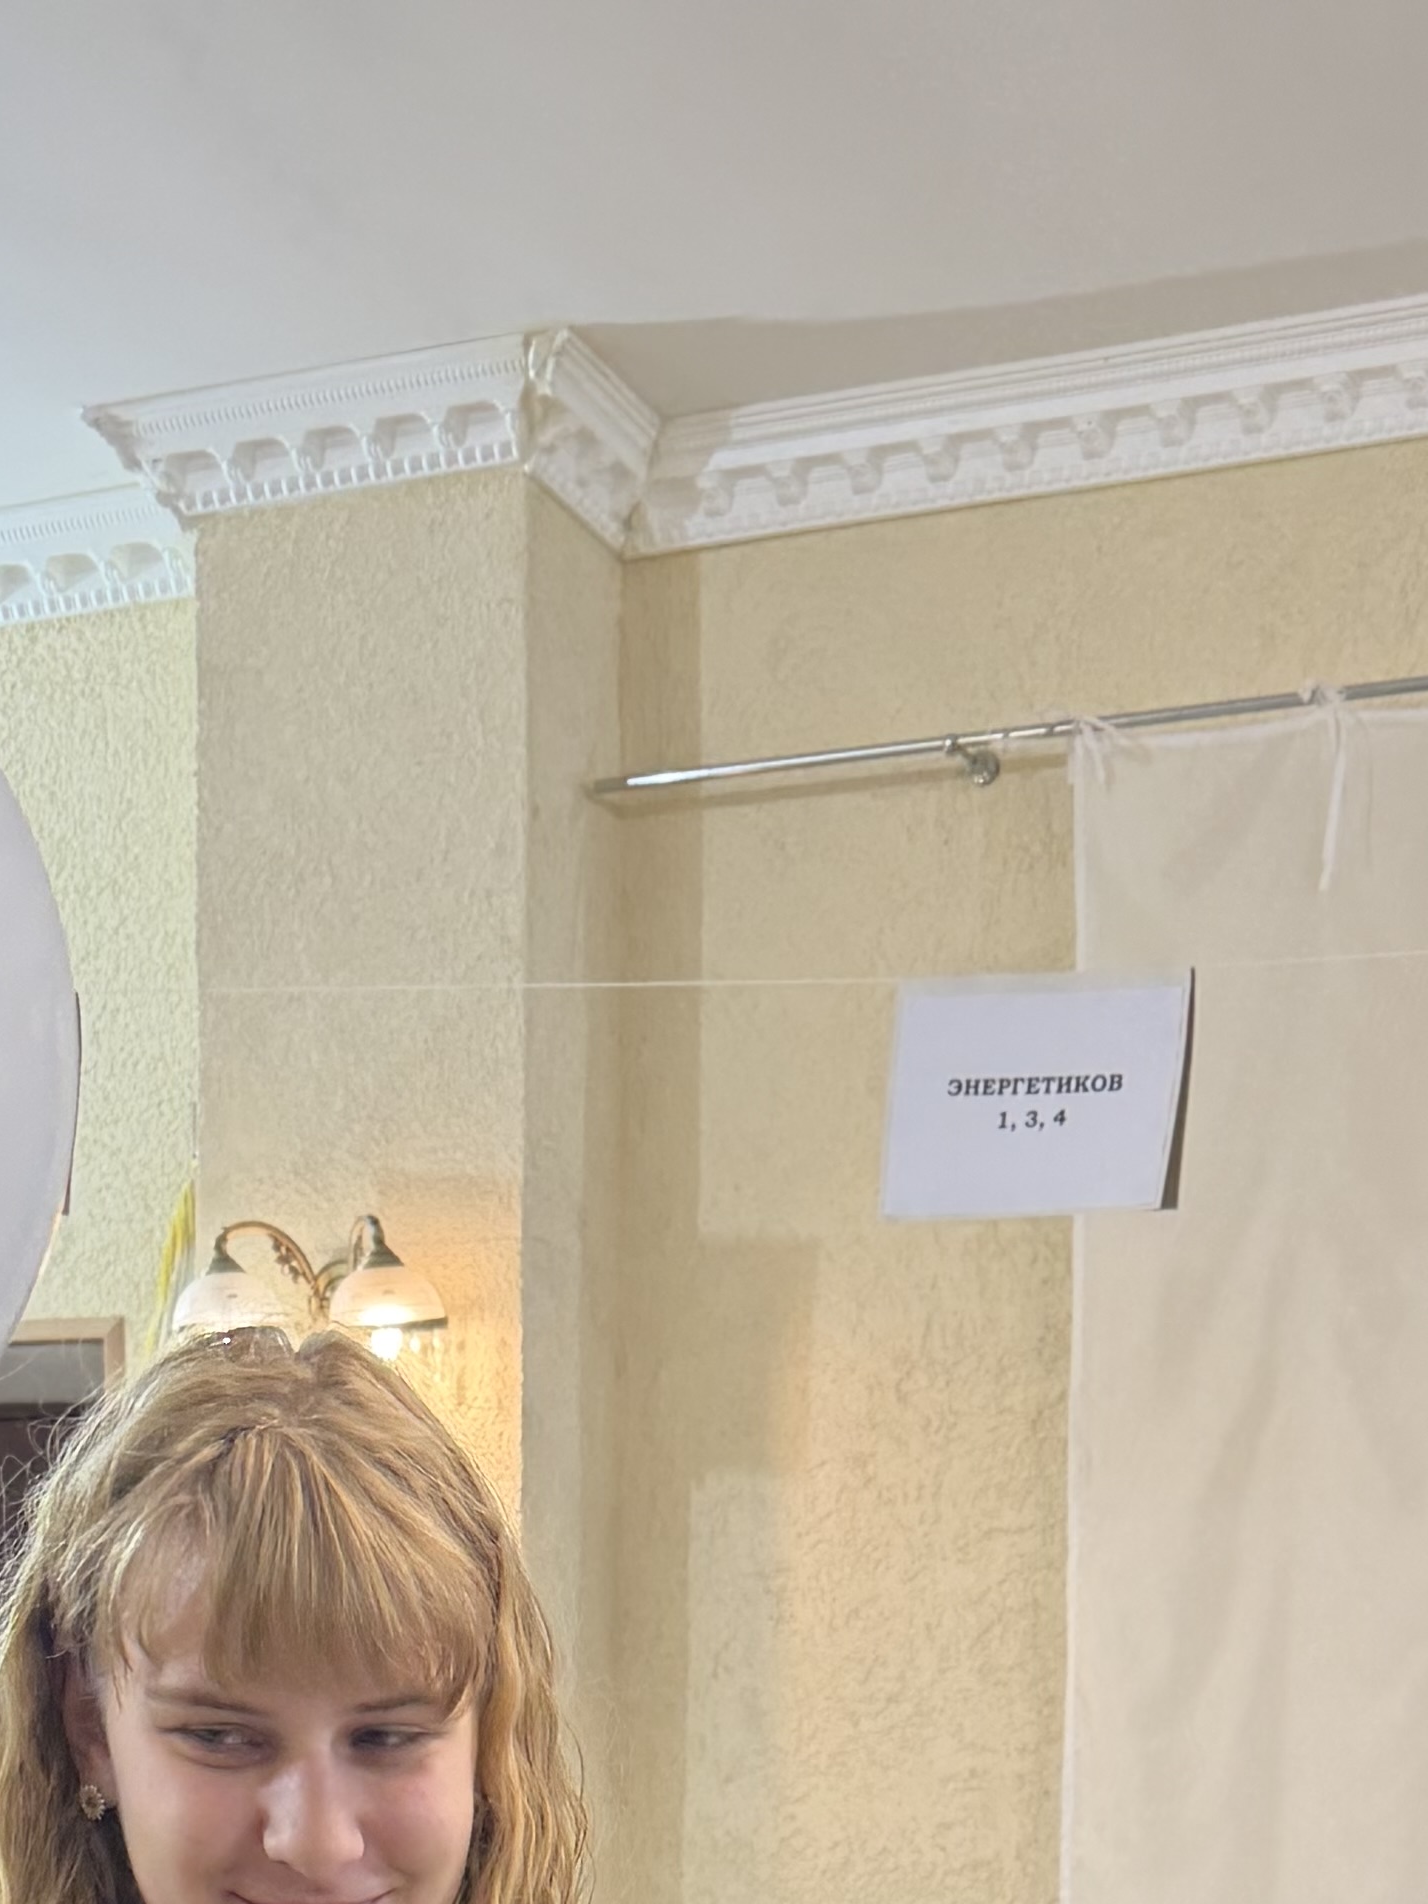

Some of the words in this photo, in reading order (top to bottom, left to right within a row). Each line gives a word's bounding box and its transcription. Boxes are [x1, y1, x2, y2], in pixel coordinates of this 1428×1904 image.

[947, 1073, 1124, 1097] ЭНЕРГЕТИКОВ
[998, 1111, 1016, 1131] 1,
[1025, 1110, 1045, 1130] 3,
[1053, 1109, 1067, 1127] 4
